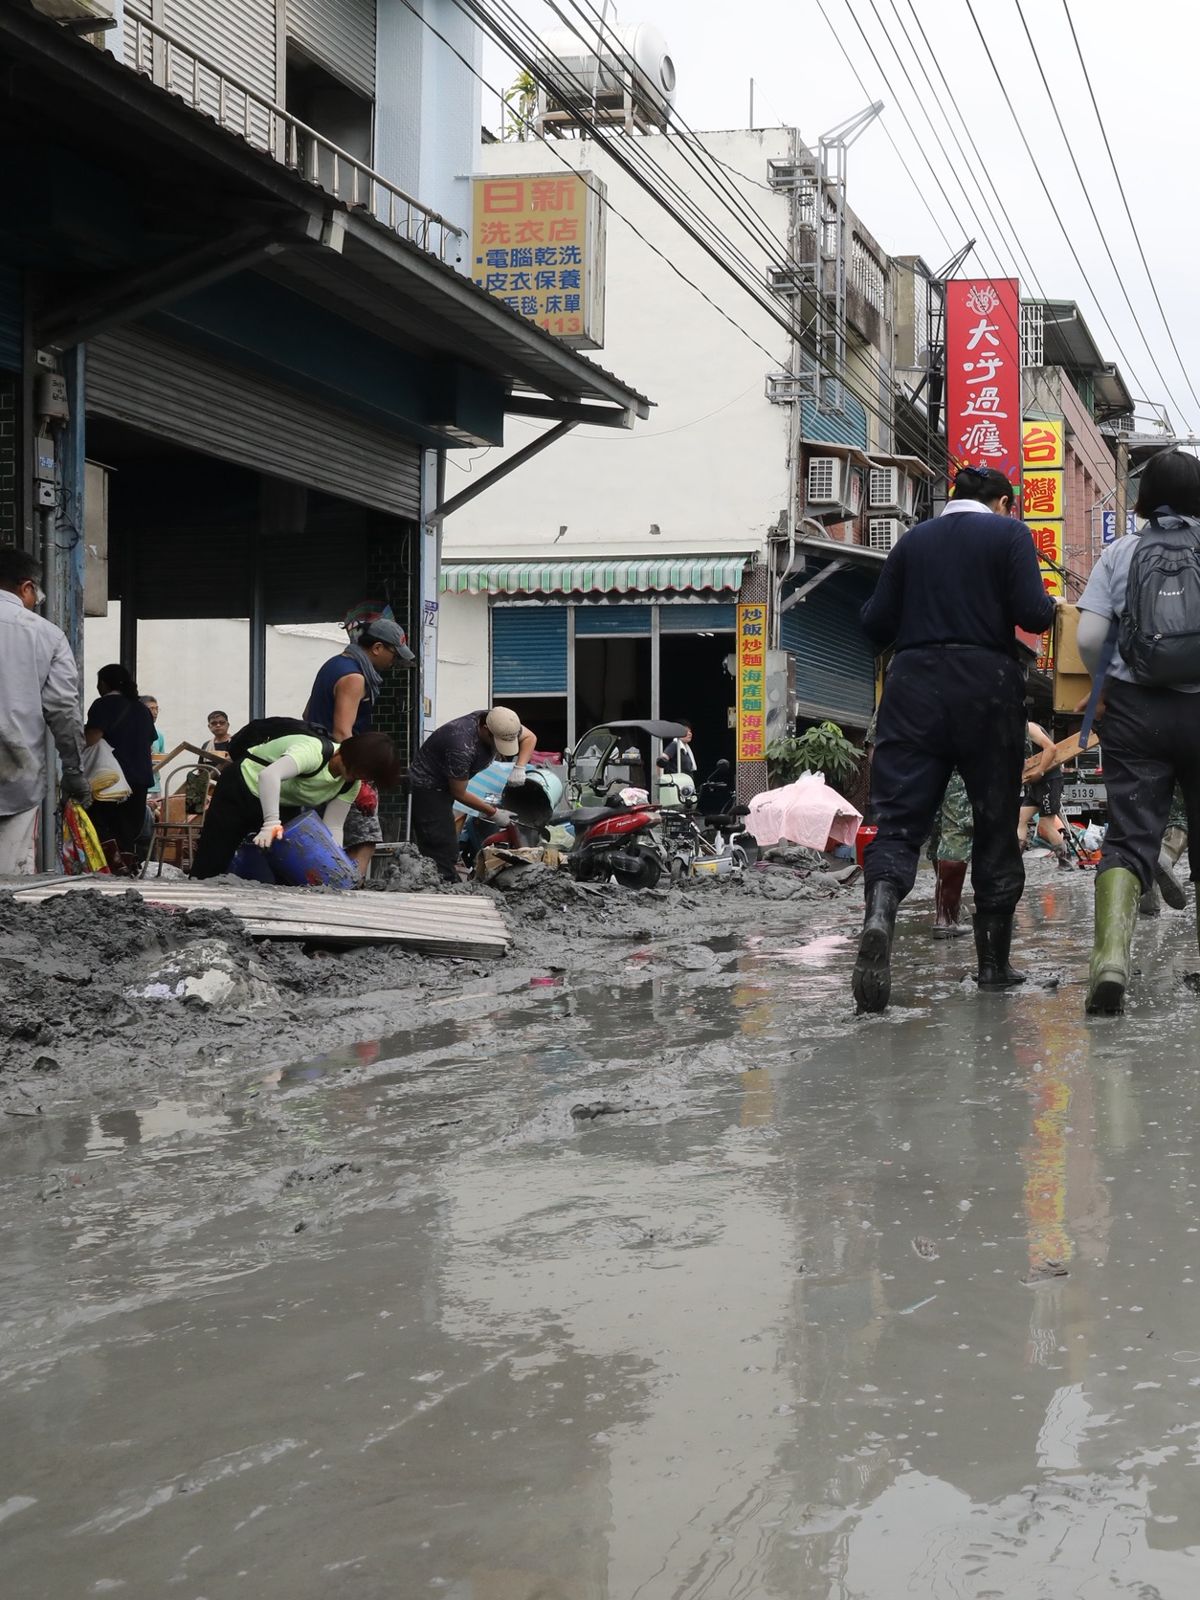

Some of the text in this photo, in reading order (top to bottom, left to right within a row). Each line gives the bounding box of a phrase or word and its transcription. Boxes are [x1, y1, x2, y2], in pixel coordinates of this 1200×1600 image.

[483, 179, 577, 213] 日新
[480, 218, 578, 244] 洗衣店
[485, 245, 582, 268] 電腦乾洗
[485, 269, 581, 292] 皮衣保養
[960, 318, 1008, 456] 大呼過癮
